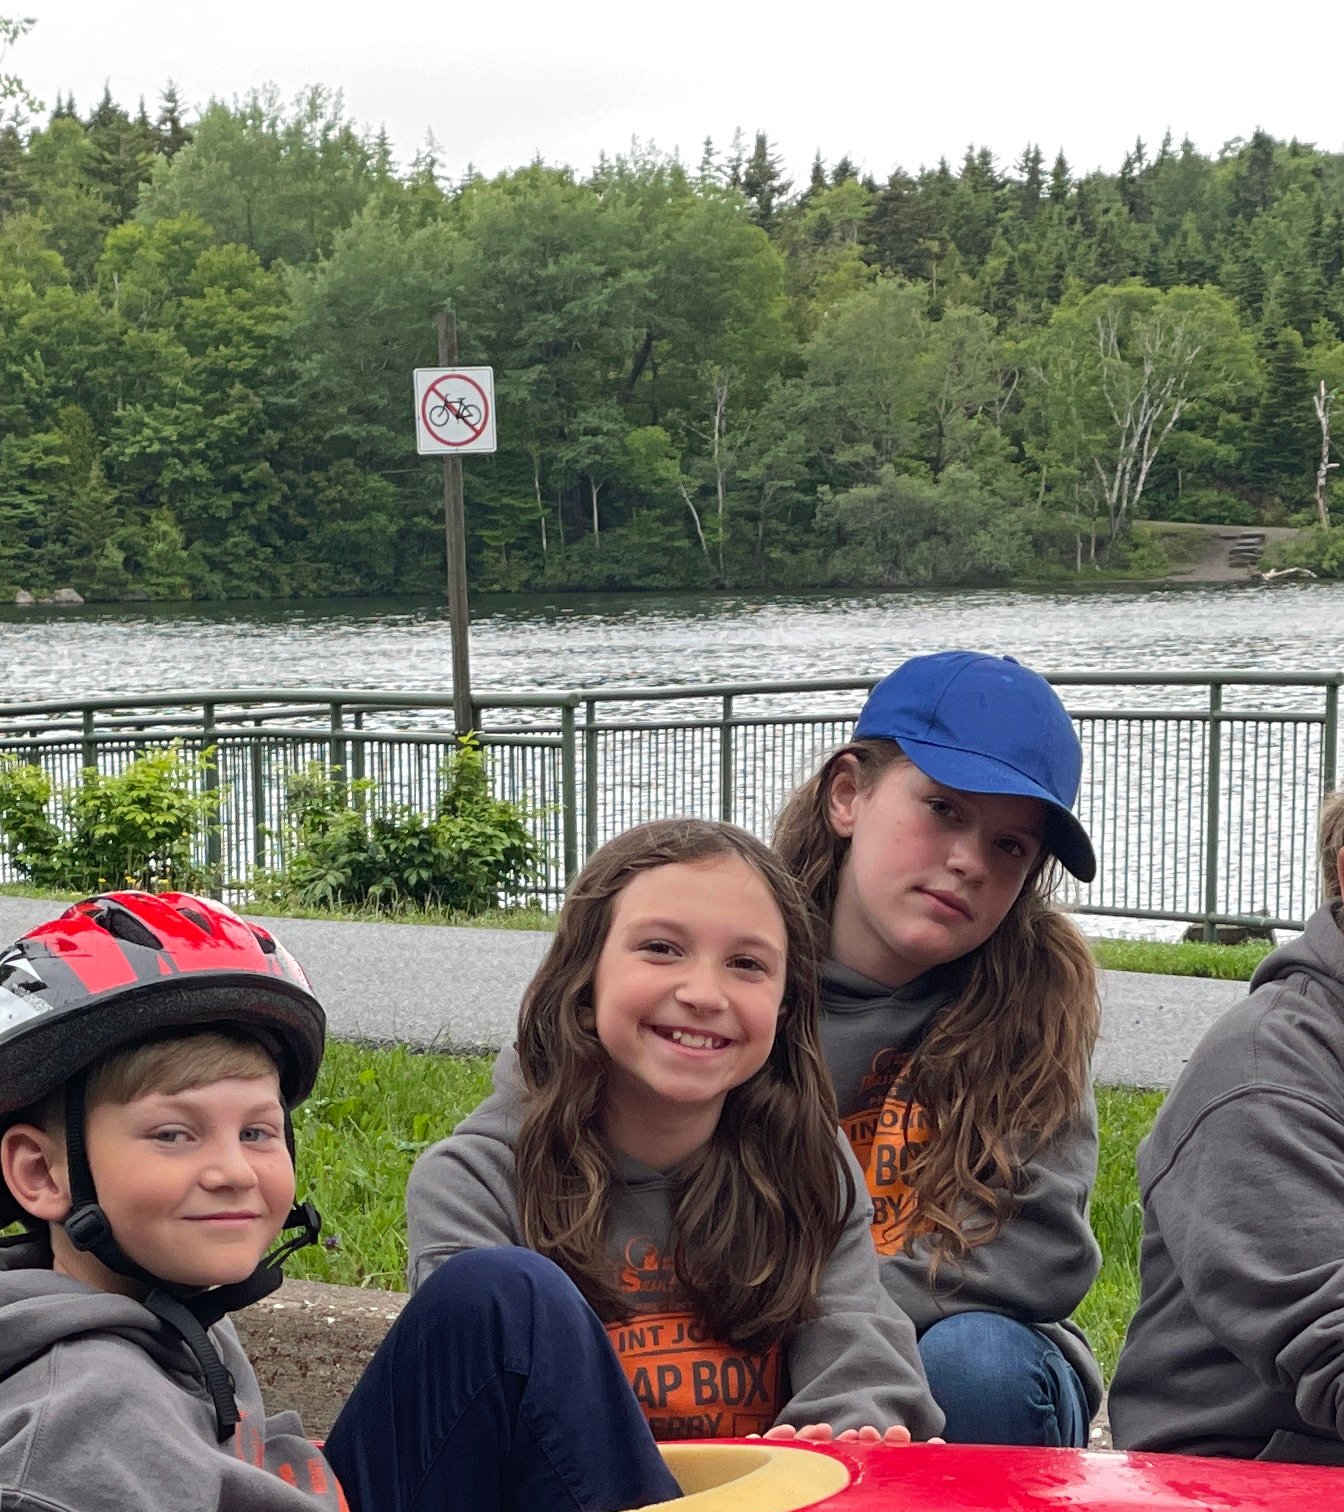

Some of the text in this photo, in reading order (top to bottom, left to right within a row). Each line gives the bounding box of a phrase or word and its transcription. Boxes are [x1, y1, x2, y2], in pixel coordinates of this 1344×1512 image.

[617, 1325, 664, 1352] INT
[632, 1356, 770, 1409] AP BOX
